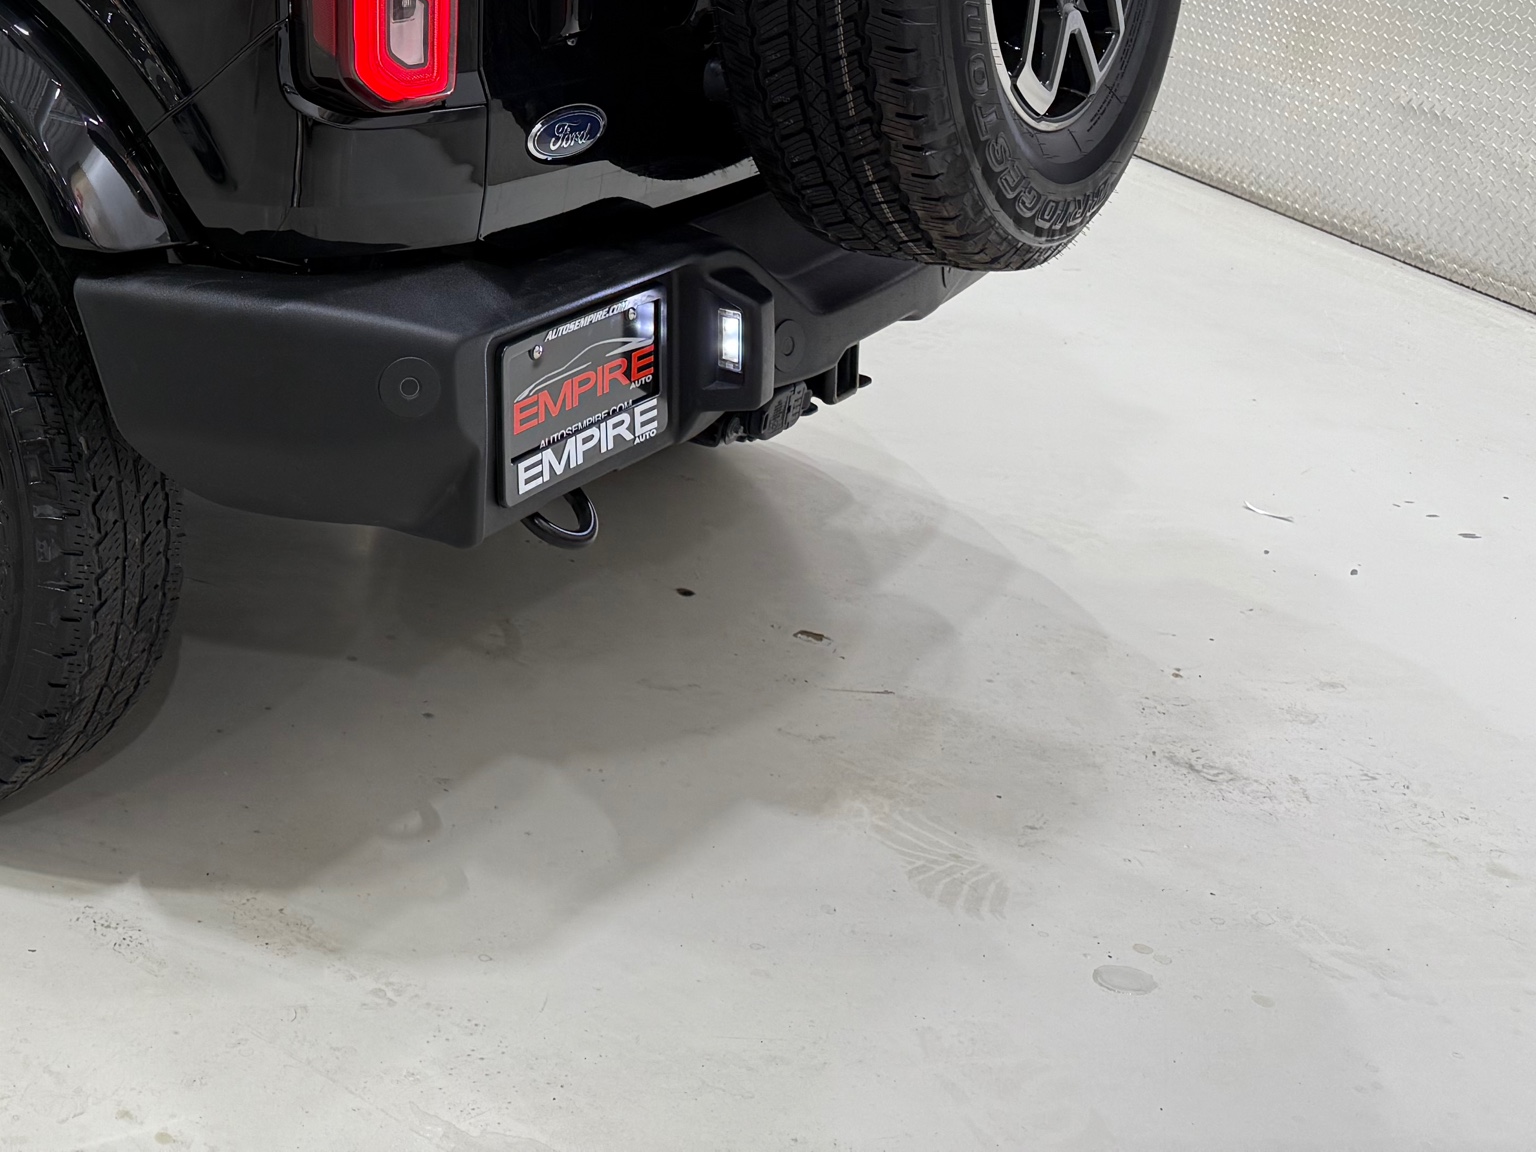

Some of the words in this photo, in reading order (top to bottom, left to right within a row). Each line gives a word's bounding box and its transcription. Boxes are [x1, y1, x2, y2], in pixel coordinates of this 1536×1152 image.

[549, 120, 591, 151] Ford
[544, 301, 630, 343] AUTOSEMPIRE.COM
[514, 345, 655, 435] EMPIRE
[629, 374, 653, 390] AUTO
[539, 399, 633, 450] AUTOSEMPIRECOM
[634, 429, 657, 446] AUTO
[518, 398, 658, 495] EMPIRE
